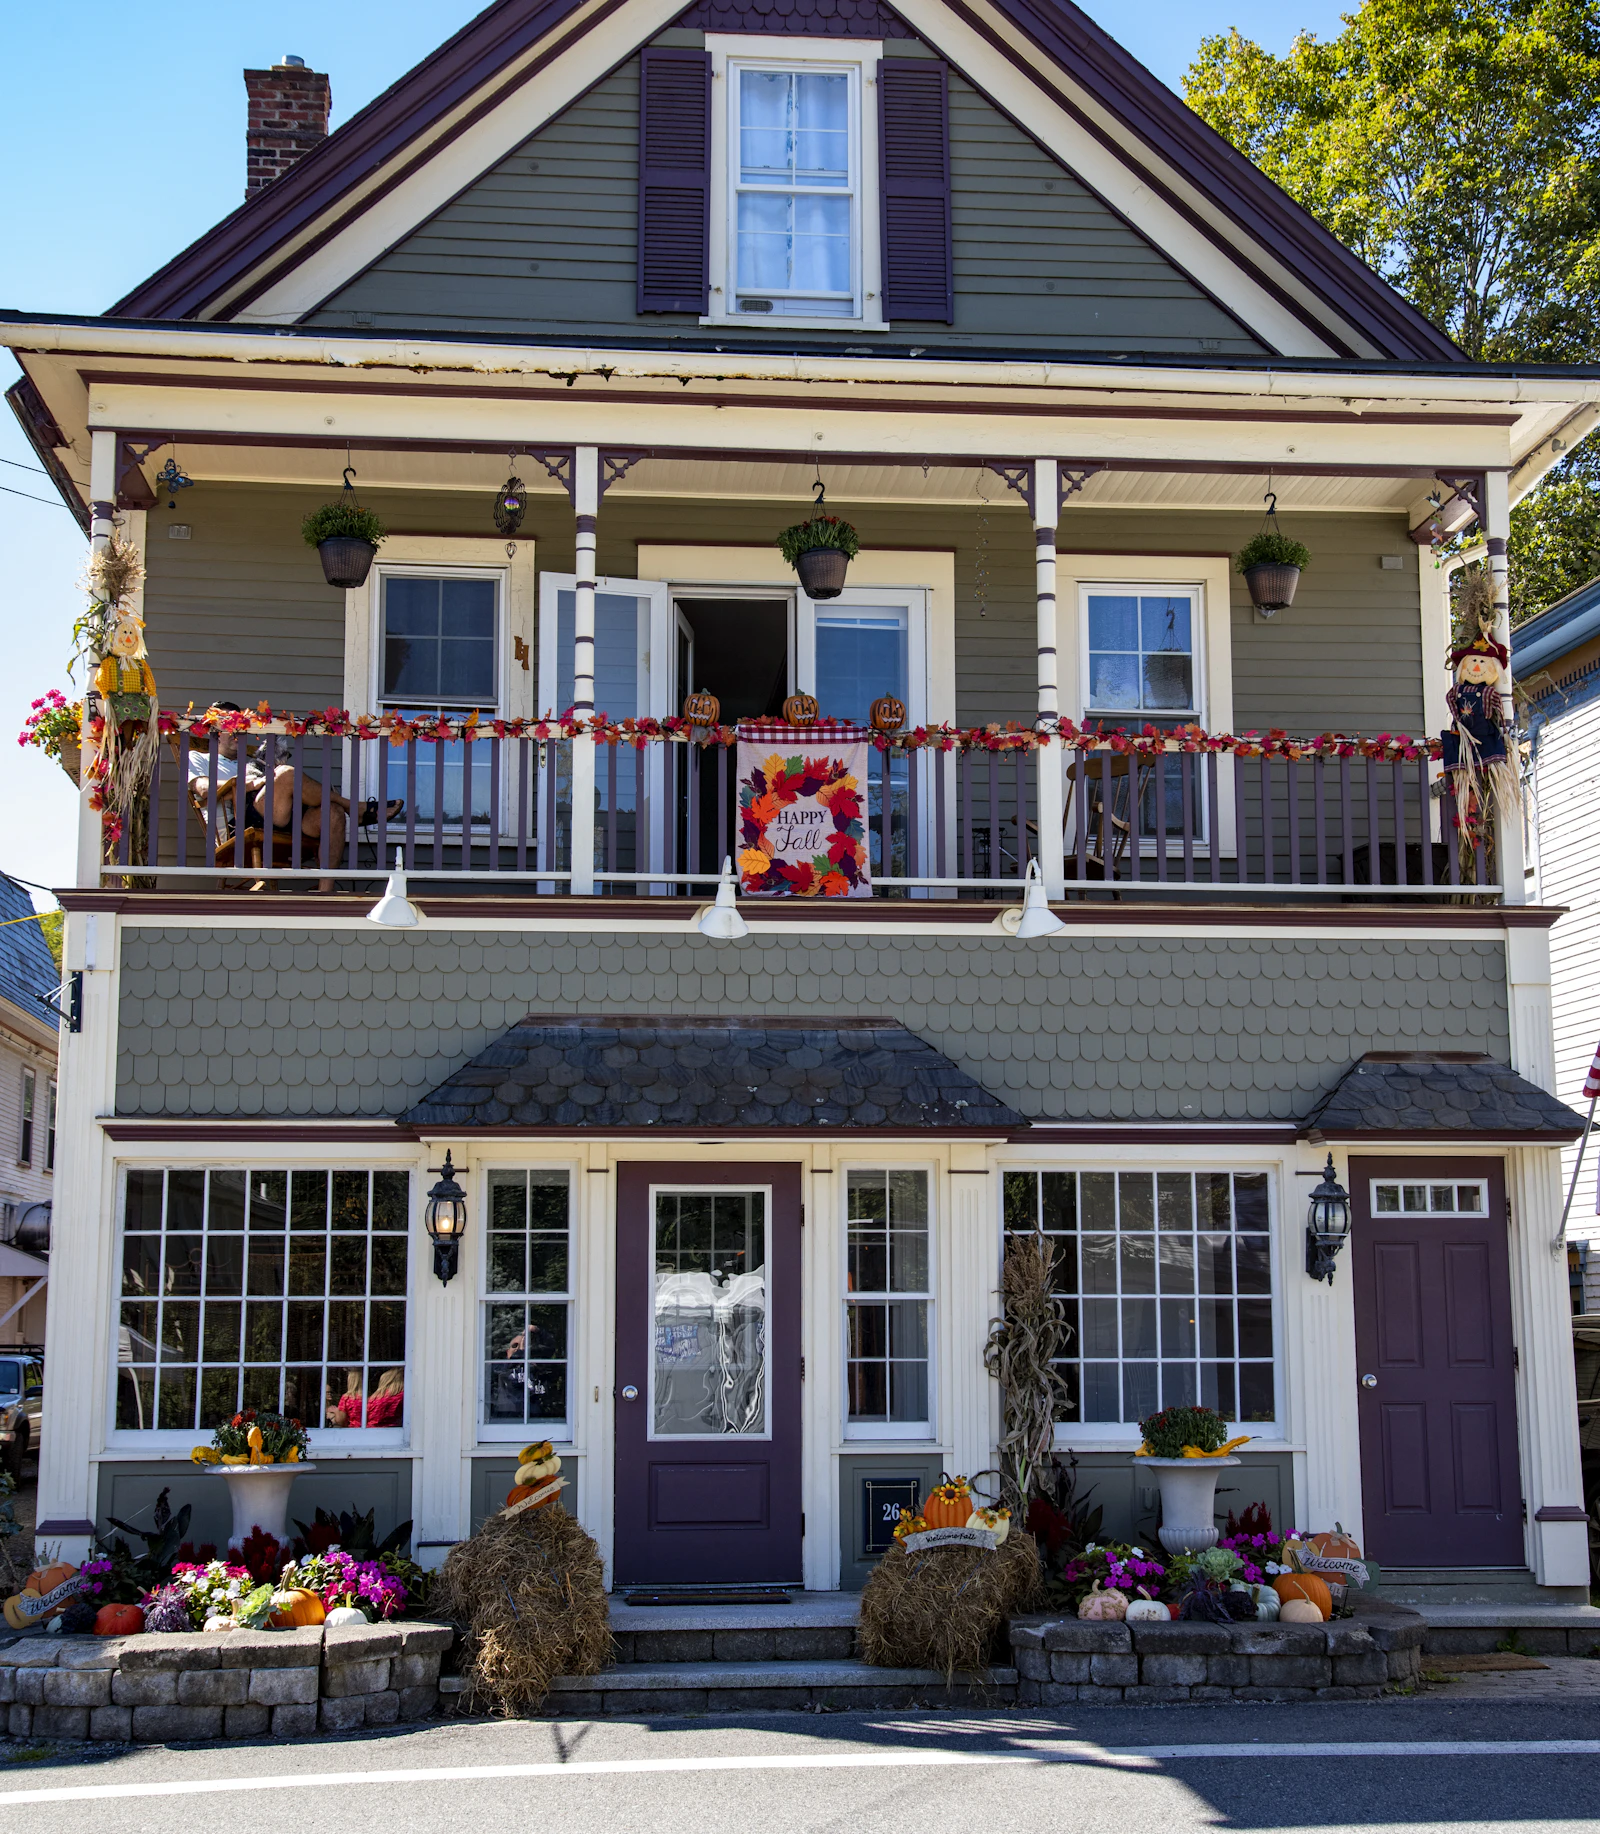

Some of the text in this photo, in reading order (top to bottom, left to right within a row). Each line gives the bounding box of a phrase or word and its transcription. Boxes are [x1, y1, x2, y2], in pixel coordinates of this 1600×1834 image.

[777, 810, 827, 825] HAPPY
[776, 825, 822, 852] Fall
[513, 1486, 555, 1510] Welcome
[882, 1502, 900, 1521] 26
[1303, 1557, 1360, 1573] Welcome
